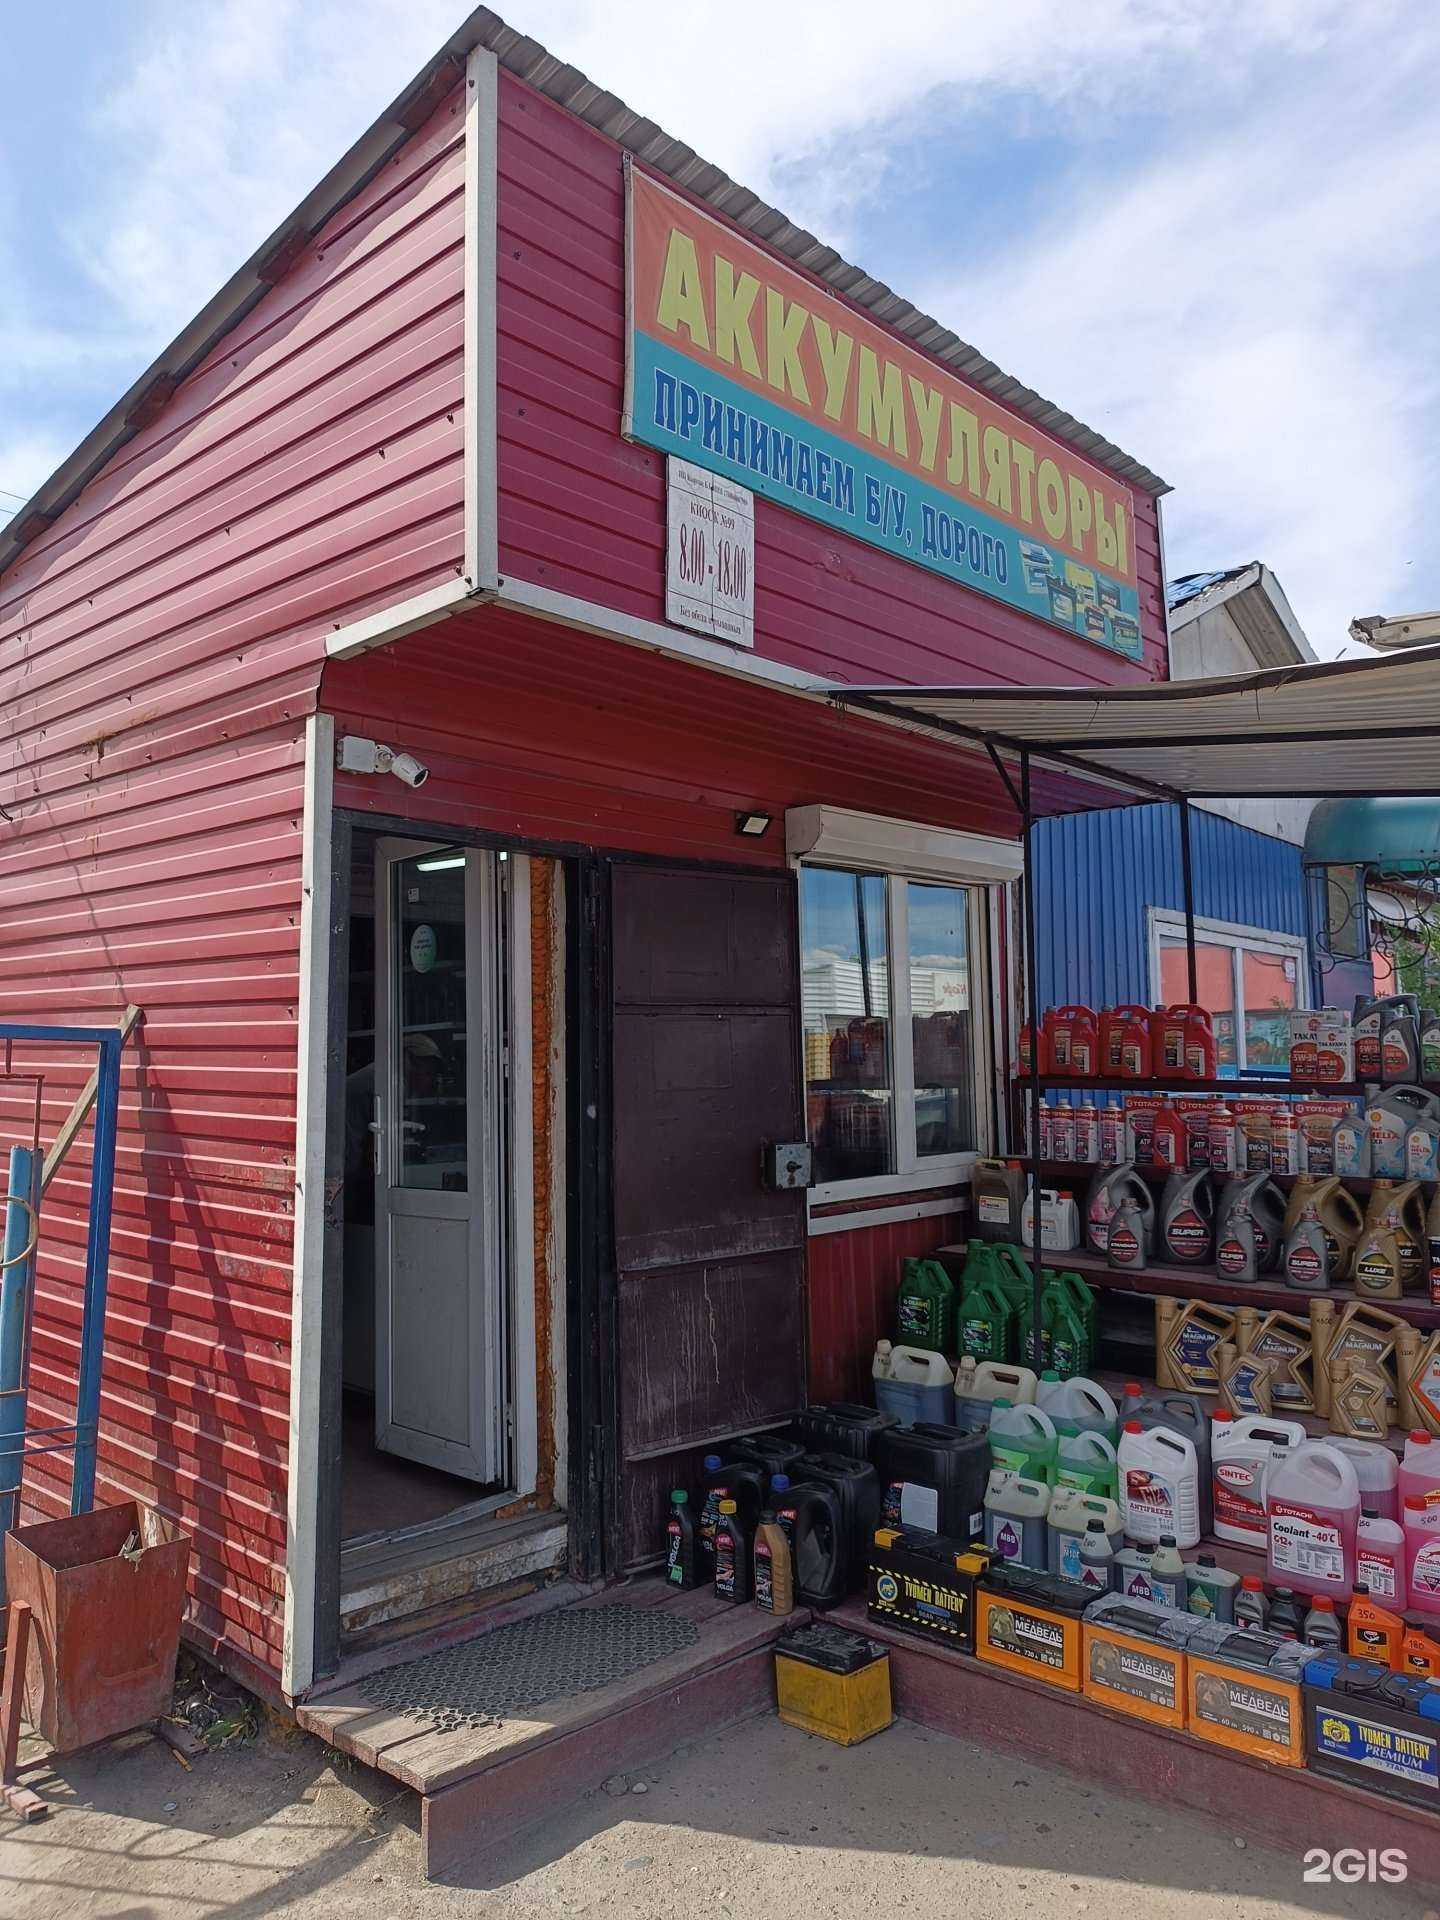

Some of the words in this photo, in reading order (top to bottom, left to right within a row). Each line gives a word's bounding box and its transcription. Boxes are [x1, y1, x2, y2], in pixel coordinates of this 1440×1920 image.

[656, 226, 1128, 576] АККУМУЛЯТОРЫ
[652, 366, 857, 517] ПРИНИМАЕМ
[864, 472, 913, 550] Б/У,
[920, 501, 1010, 586] ДОРОГО
[690, 501, 719, 524] КИОСК
[680, 522, 705, 586] 8.00
[717, 538, 747, 602] 18.00
[1133, 1100, 1161, 1108] TOTACH
[1187, 1102, 1215, 1110] TOTACH
[1242, 1104, 1275, 1113] TOTACH
[1305, 1106, 1344, 1114] TOTACHI
[1171, 1228, 1204, 1239] SUPER
[1110, 1240, 1138, 1249] STANDARD
[1219, 1252, 1244, 1261] SUPER
[1291, 1259, 1318, 1269] SUPER
[1364, 1266, 1387, 1275] LUXE
[1182, 1332, 1216, 1342] MAGNUM
[1262, 1344, 1298, 1354] MAGNUM
[1345, 1342, 1383, 1351] MAGNUM
[1218, 1466, 1252, 1483] SINTEC
[1129, 1502, 1175, 1516] ANTIFREEZE
[1283, 1509, 1313, 1520] TOTACHI
[1273, 1521, 1310, 1539] Coolant
[667, 1535, 681, 1568] VOLGA
[1359, 1562, 1380, 1571] Coolant
[717, 1582, 734, 1593] VOLGA
[904, 1581, 932, 1603] TYUMEN
[934, 1591, 964, 1615] BATTERY
[1358, 1609, 1376, 1620] 350
[1015, 1620, 1063, 1644] МЕДВЕДЬ
[1121, 1656, 1175, 1682] МЕДВЕДЬ
[1230, 1690, 1290, 1717] МЕДВЕДЬ
[1358, 1725, 1391, 1744] TYUMEN
[1395, 1735, 1430, 1760] BATTERY
[1365, 1743, 1424, 1770] PREMIUM
